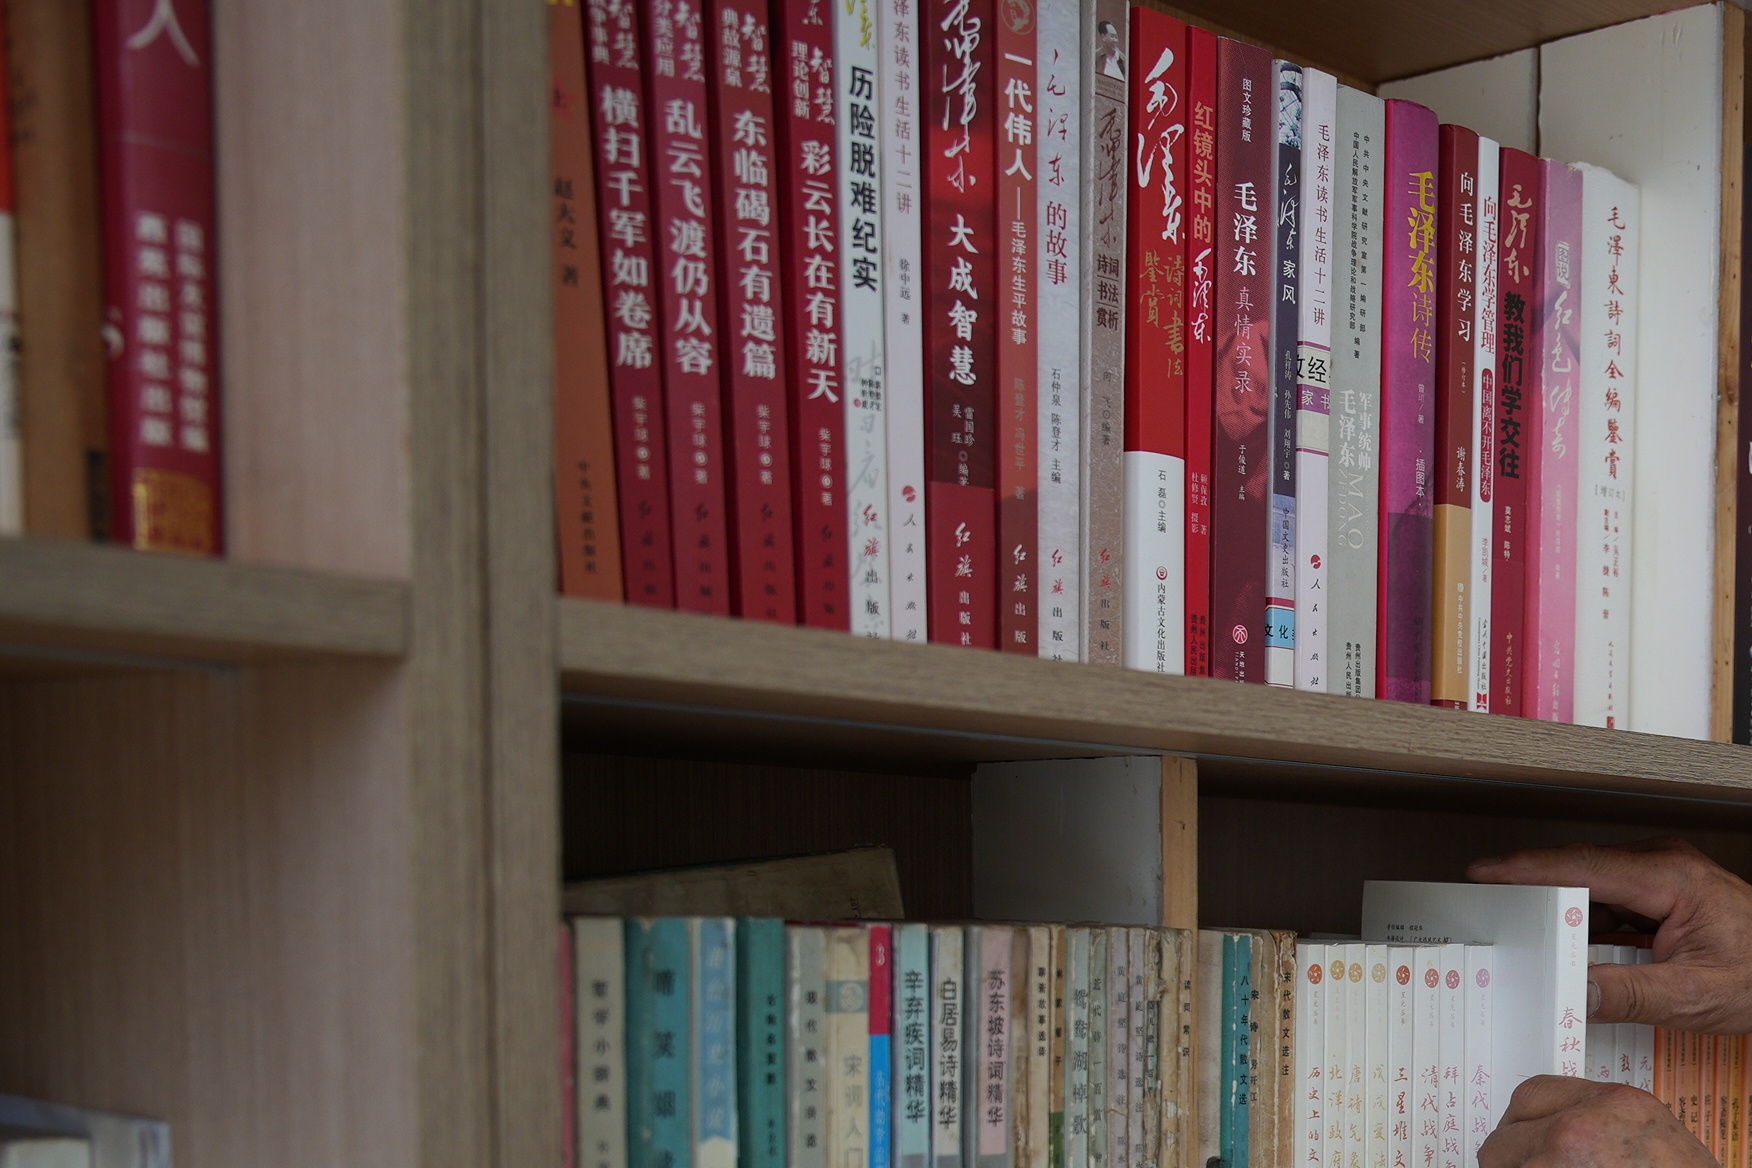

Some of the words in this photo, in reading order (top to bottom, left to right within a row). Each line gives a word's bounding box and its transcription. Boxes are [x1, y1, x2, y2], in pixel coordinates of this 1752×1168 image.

[849, 66, 879, 293] 历险脱难纪实
[1004, 53, 1033, 181] 一代伟人
[1192, 101, 1216, 243] 红镜头中的
[1242, 78, 1252, 142] 图文珍藏版
[602, 85, 653, 368] 横扫千军如卷席
[664, 99, 713, 376] 乱云飞渡仍从容
[733, 110, 778, 380] 东临碣石有遗篇
[800, 140, 840, 404] 彩云长在有新天
[1046, 199, 1069, 289] 的故事
[1232, 180, 1258, 276] 毛泽东
[1280, 259, 1298, 305] 家风
[1312, 124, 1331, 327] 毛泽东读书生活十二讲
[1407, 170, 1436, 364] 毛泽东诗传
[1457, 171, 1475, 343] 向毛泽东学习
[1480, 195, 1498, 354] 向毛泽东学管理
[948, 213, 982, 386] 大成智慧
[1233, 286, 1254, 394] 真情实录
[1050, 368, 1062, 407] 石仲泉
[1050, 413, 1062, 451] 陈登才
[1338, 390, 1355, 467] 毛泽东
[1356, 391, 1372, 471] 军事统帅
[1480, 373, 1493, 496] 中国离不开毛泽东
[1499, 289, 1528, 479] 教我们学交往
[1050, 458, 1062, 485] 主编
[1455, 445, 1467, 493] 谢春涛
[1156, 582, 1167, 676] 内蒙古文化出版社
[1264, 622, 1296, 649] 文化
[904, 969, 927, 1125] 辛弃疾词精华
[938, 978, 959, 1131] 白居易诗精华
[986, 968, 1006, 1128] 苏东坡诗词精华
[1073, 988, 1089, 1136] 鸳鸯湖棹歌
[1117, 965, 1128, 1106] 黄庭坚诗选注
[1134, 973, 1145, 1114] 黄庭坚诗选注
[1239, 975, 1250, 1105] 八十年代散文选
[1280, 970, 1291, 1078] 宋代散文选注
